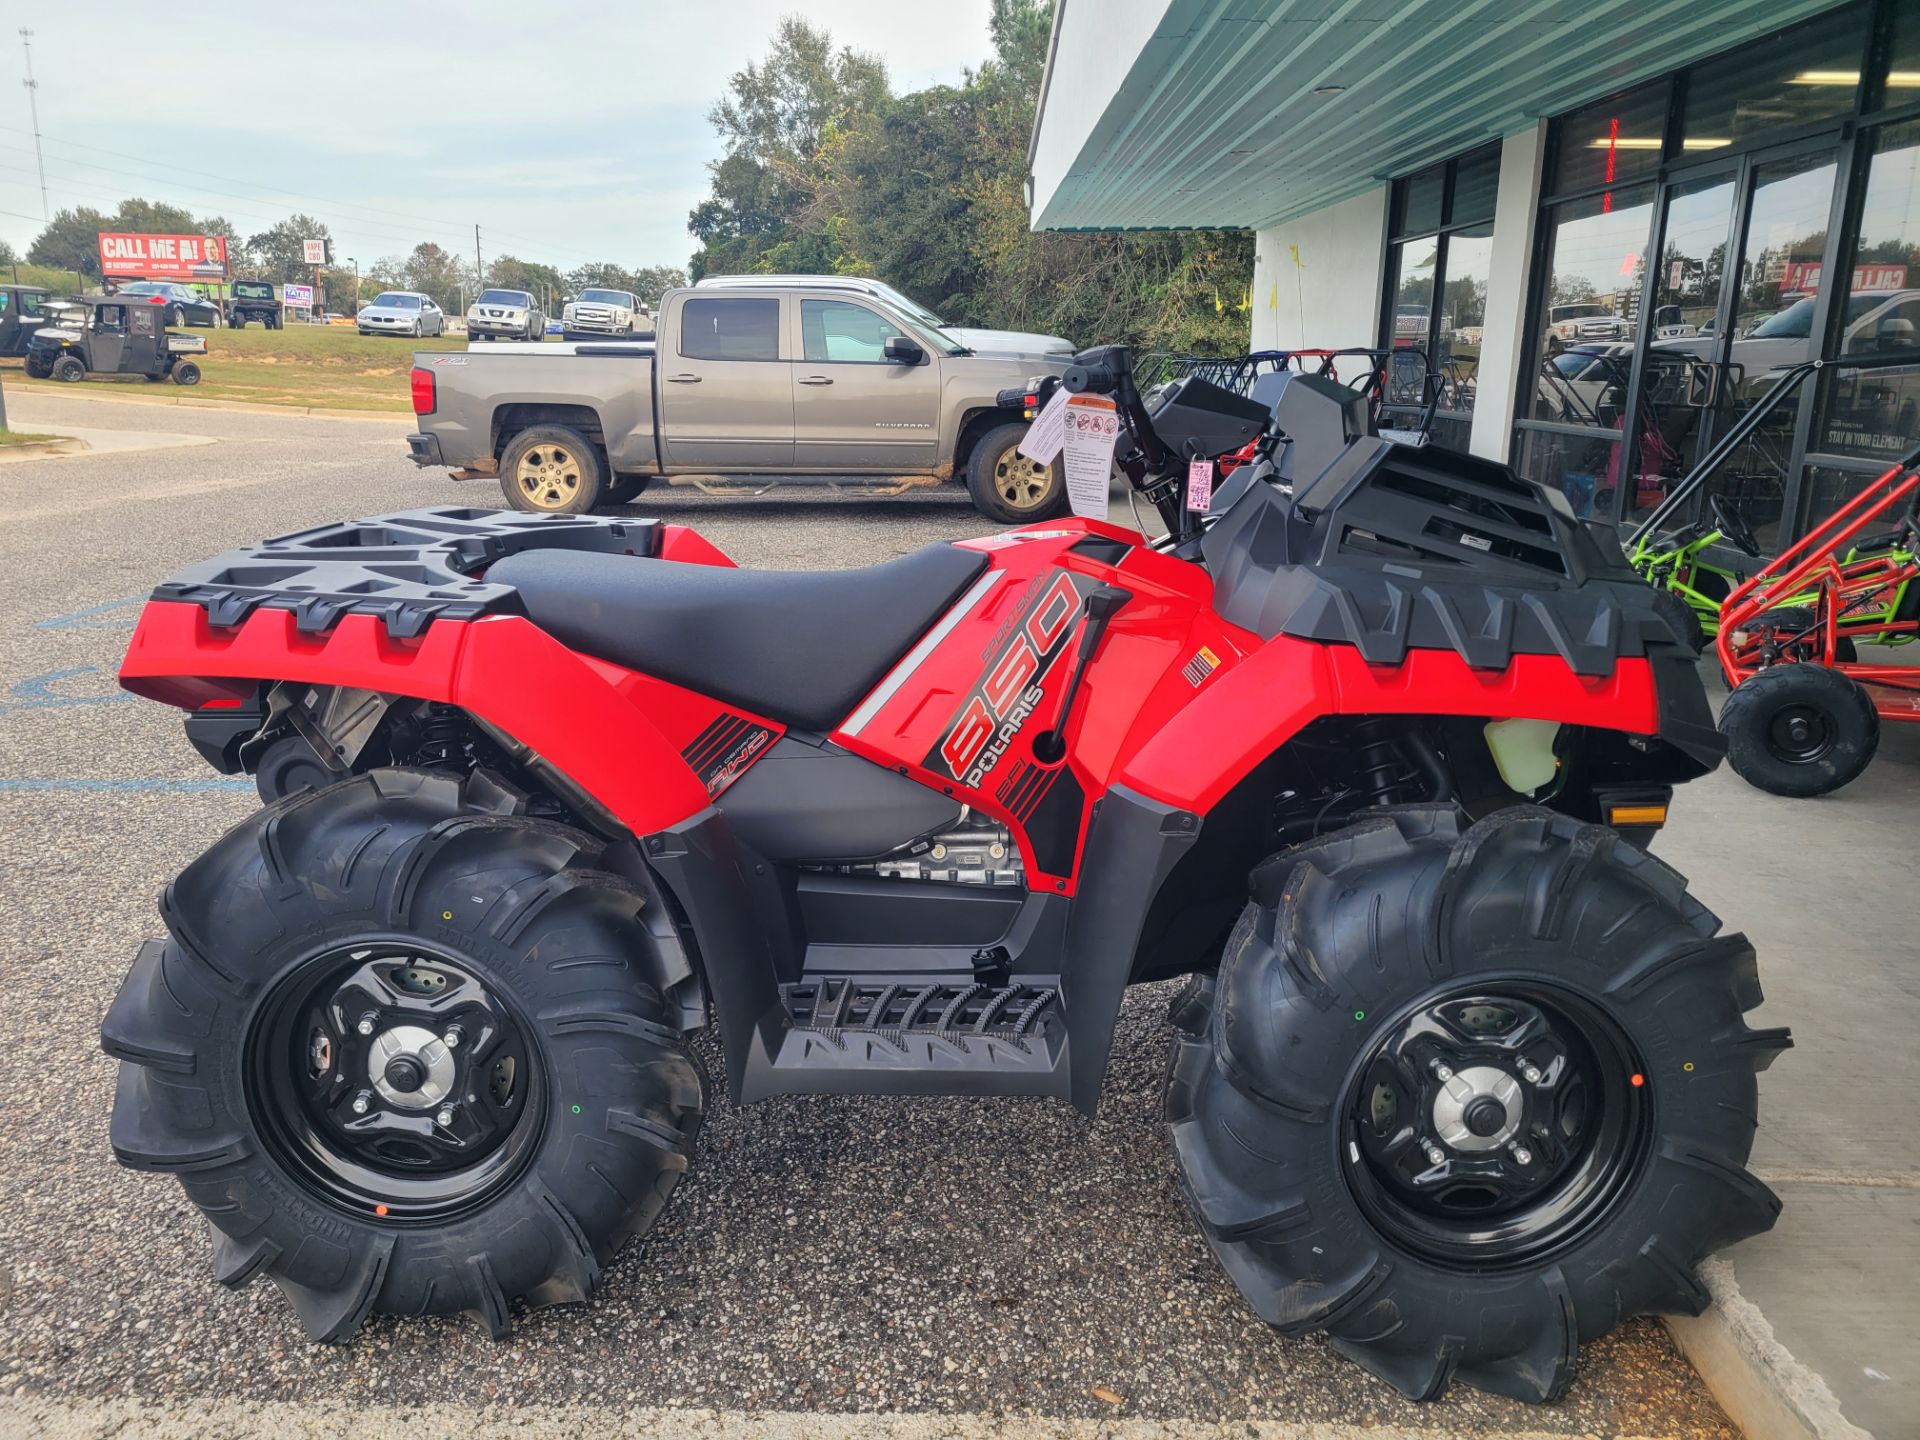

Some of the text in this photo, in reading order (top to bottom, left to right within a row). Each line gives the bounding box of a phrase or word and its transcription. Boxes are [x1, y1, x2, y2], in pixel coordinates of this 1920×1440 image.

[102, 238, 147, 259] CALL
[149, 239, 176, 260] ME
[306, 242, 321, 251] VAPE
[308, 252, 321, 261] CBD
[1828, 430, 1906, 450] STAY IN YOUR ELEMENT
[982, 569, 1047, 661] SPORTSMAN
[940, 571, 1082, 781] 850
[968, 683, 1045, 790] POLARIS
[707, 730, 769, 793] AWD
[995, 756, 1027, 803] EFI
